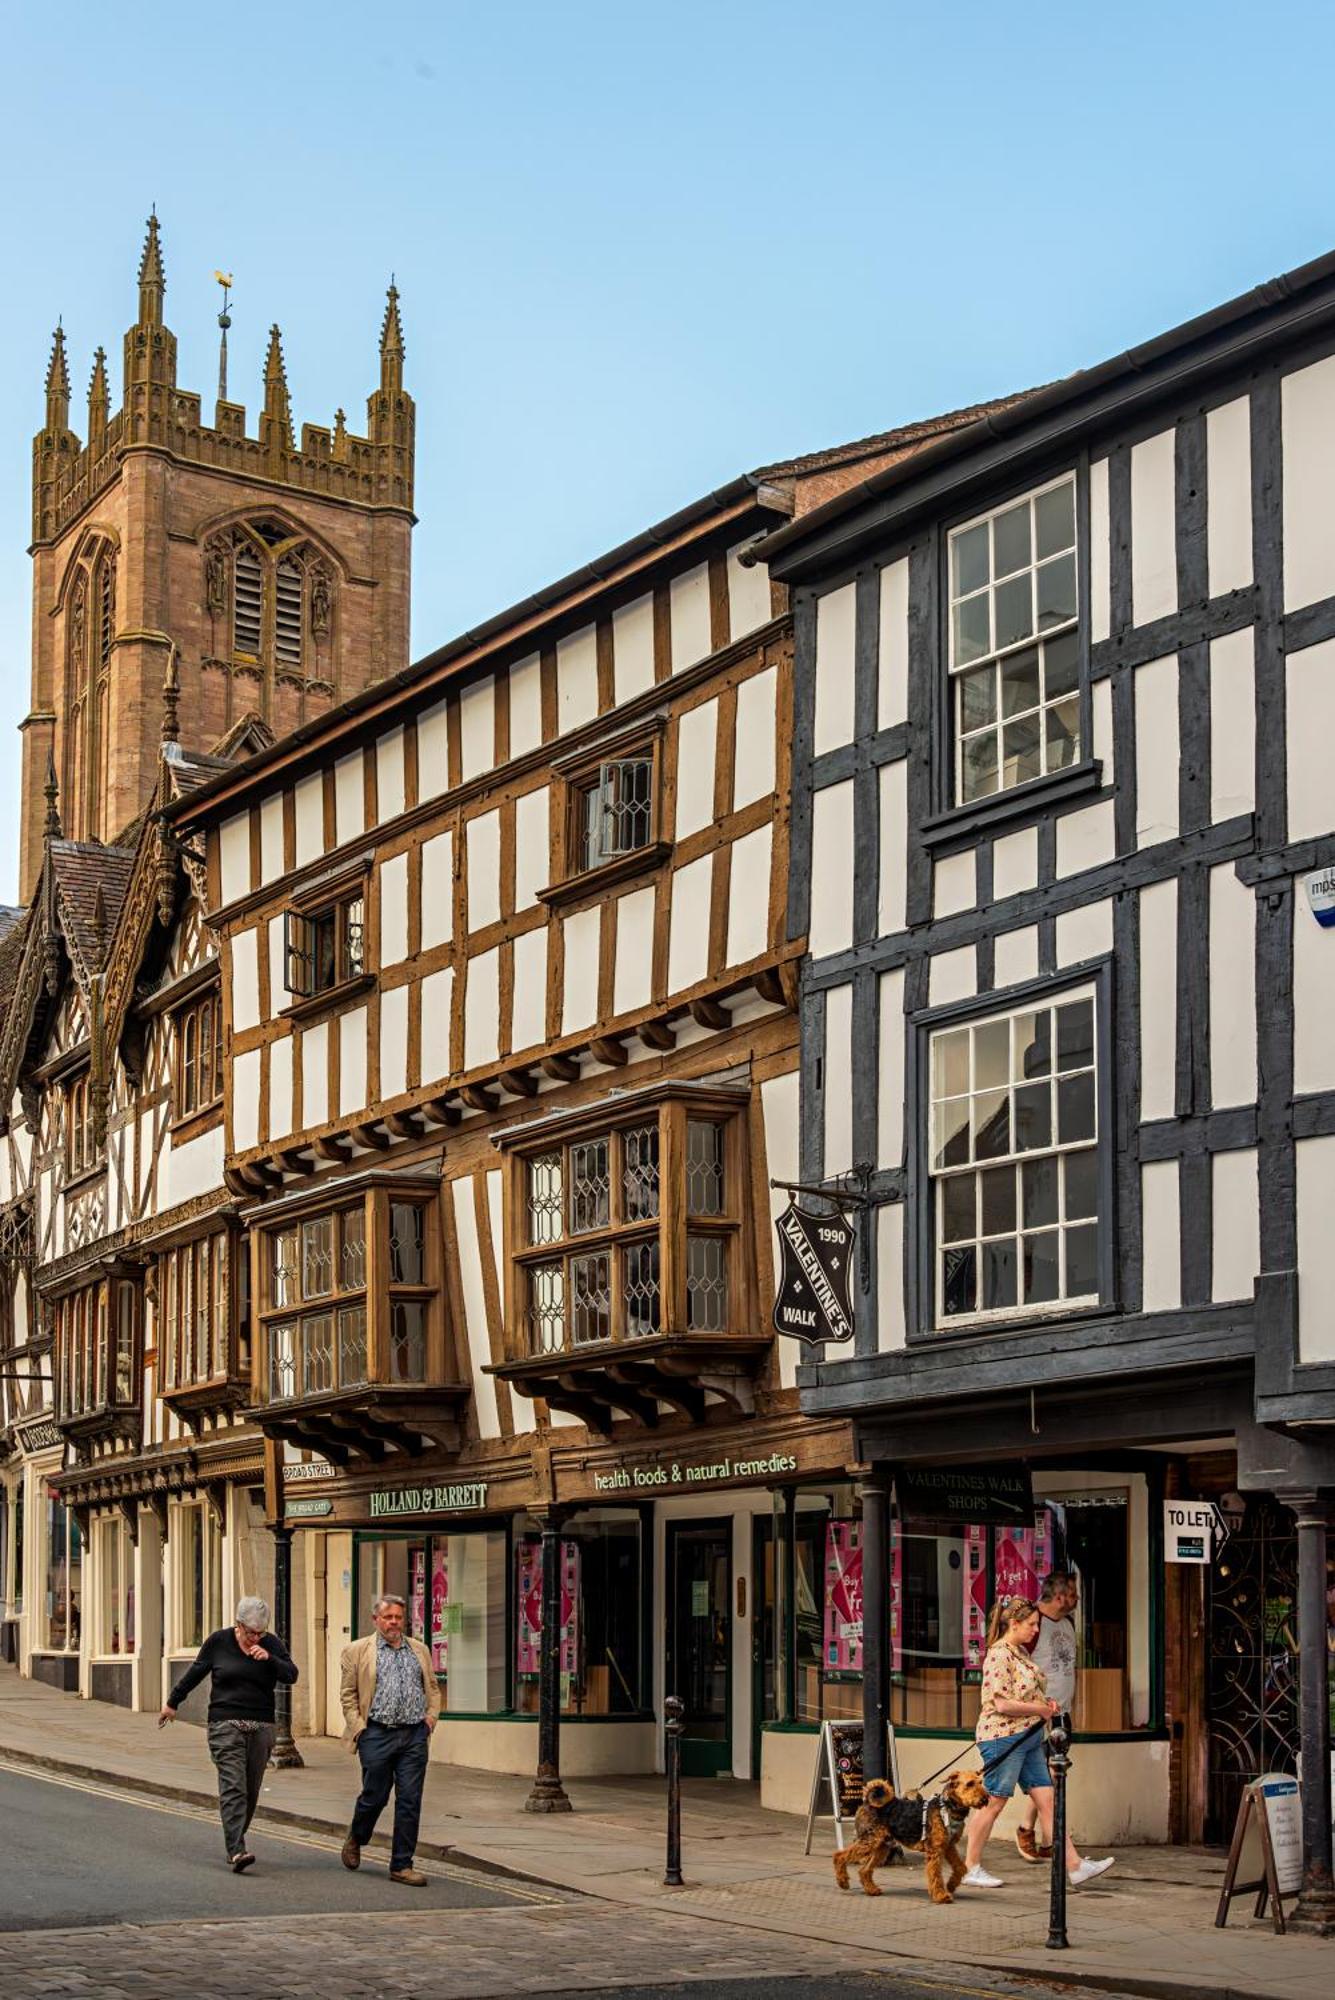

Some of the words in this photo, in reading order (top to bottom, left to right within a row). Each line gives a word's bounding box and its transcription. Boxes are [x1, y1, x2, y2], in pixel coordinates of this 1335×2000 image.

[817, 1227, 846, 1245] 1990
[785, 1216, 848, 1336] VALENTINE'S
[783, 1306, 816, 1327] WALK
[284, 1466, 307, 1479] BROAD
[307, 1464, 333, 1478] STREET
[594, 1470, 630, 1490] health
[633, 1466, 667, 1487] foods
[671, 1463, 682, 1482] &
[686, 1458, 730, 1481] natural
[734, 1453, 796, 1476] remedies
[987, 1476, 1024, 1492] WALK
[370, 1490, 420, 1517] HOLLAND
[422, 1488, 433, 1513] &
[434, 1483, 488, 1508] BARRETT
[947, 1495, 988, 1510] SHOPS
[1168, 1510, 1185, 1526] TO
